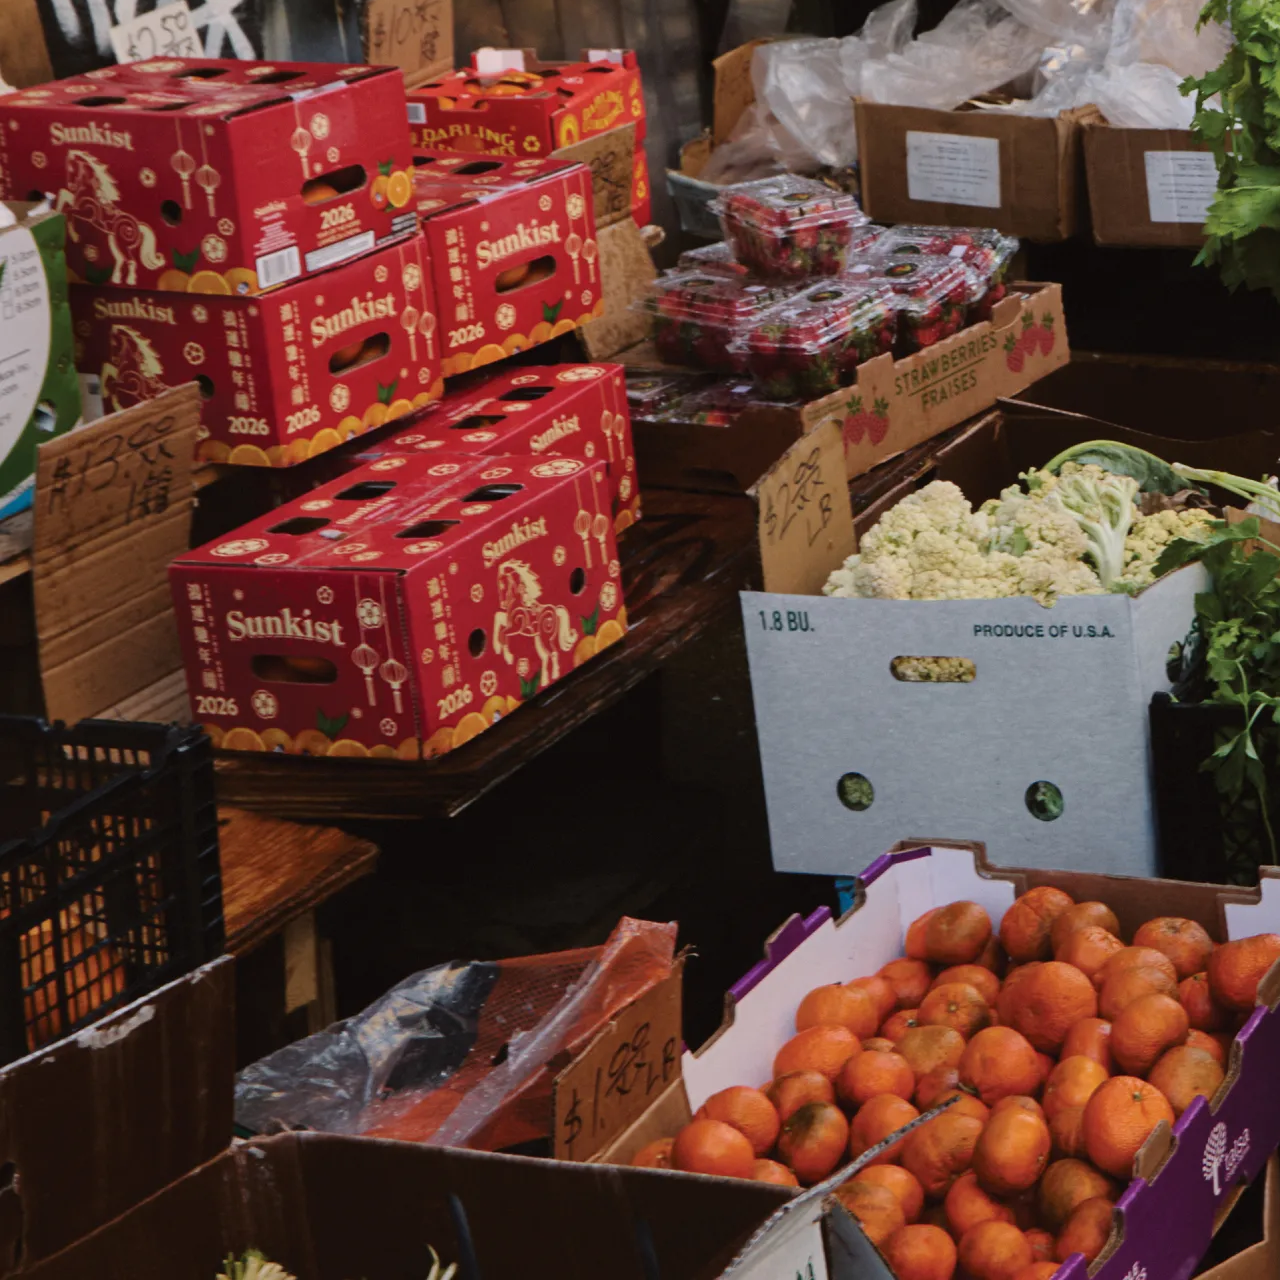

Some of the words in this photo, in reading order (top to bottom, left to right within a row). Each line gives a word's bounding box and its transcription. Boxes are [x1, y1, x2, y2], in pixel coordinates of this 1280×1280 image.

[50, 122, 134, 151] Sunkist
[421, 123, 515, 147] DARLING
[320, 202, 356, 230] 2026
[476, 219, 561, 270] Sunkist
[95, 296, 176, 325] Sunkist
[310, 292, 398, 348] Sunkist
[449, 321, 485, 348] 2026
[894, 331, 998, 396] STRAWBERRIES
[921, 368, 978, 411] FRAISES
[227, 416, 270, 436] 2026
[285, 404, 321, 435] 2026
[529, 414, 581, 452] Sunkist
[481, 515, 547, 567] Sunkist
[226, 609, 346, 646] Sunkist
[758, 610, 783, 631] 1.8
[787, 610, 815, 632] BU.
[973, 624, 1044, 638] PRODUCE
[1048, 624, 1068, 638] OF
[1072, 625, 1115, 638] U.S.A.
[195, 695, 239, 716] 2026
[437, 683, 473, 720] 2026
